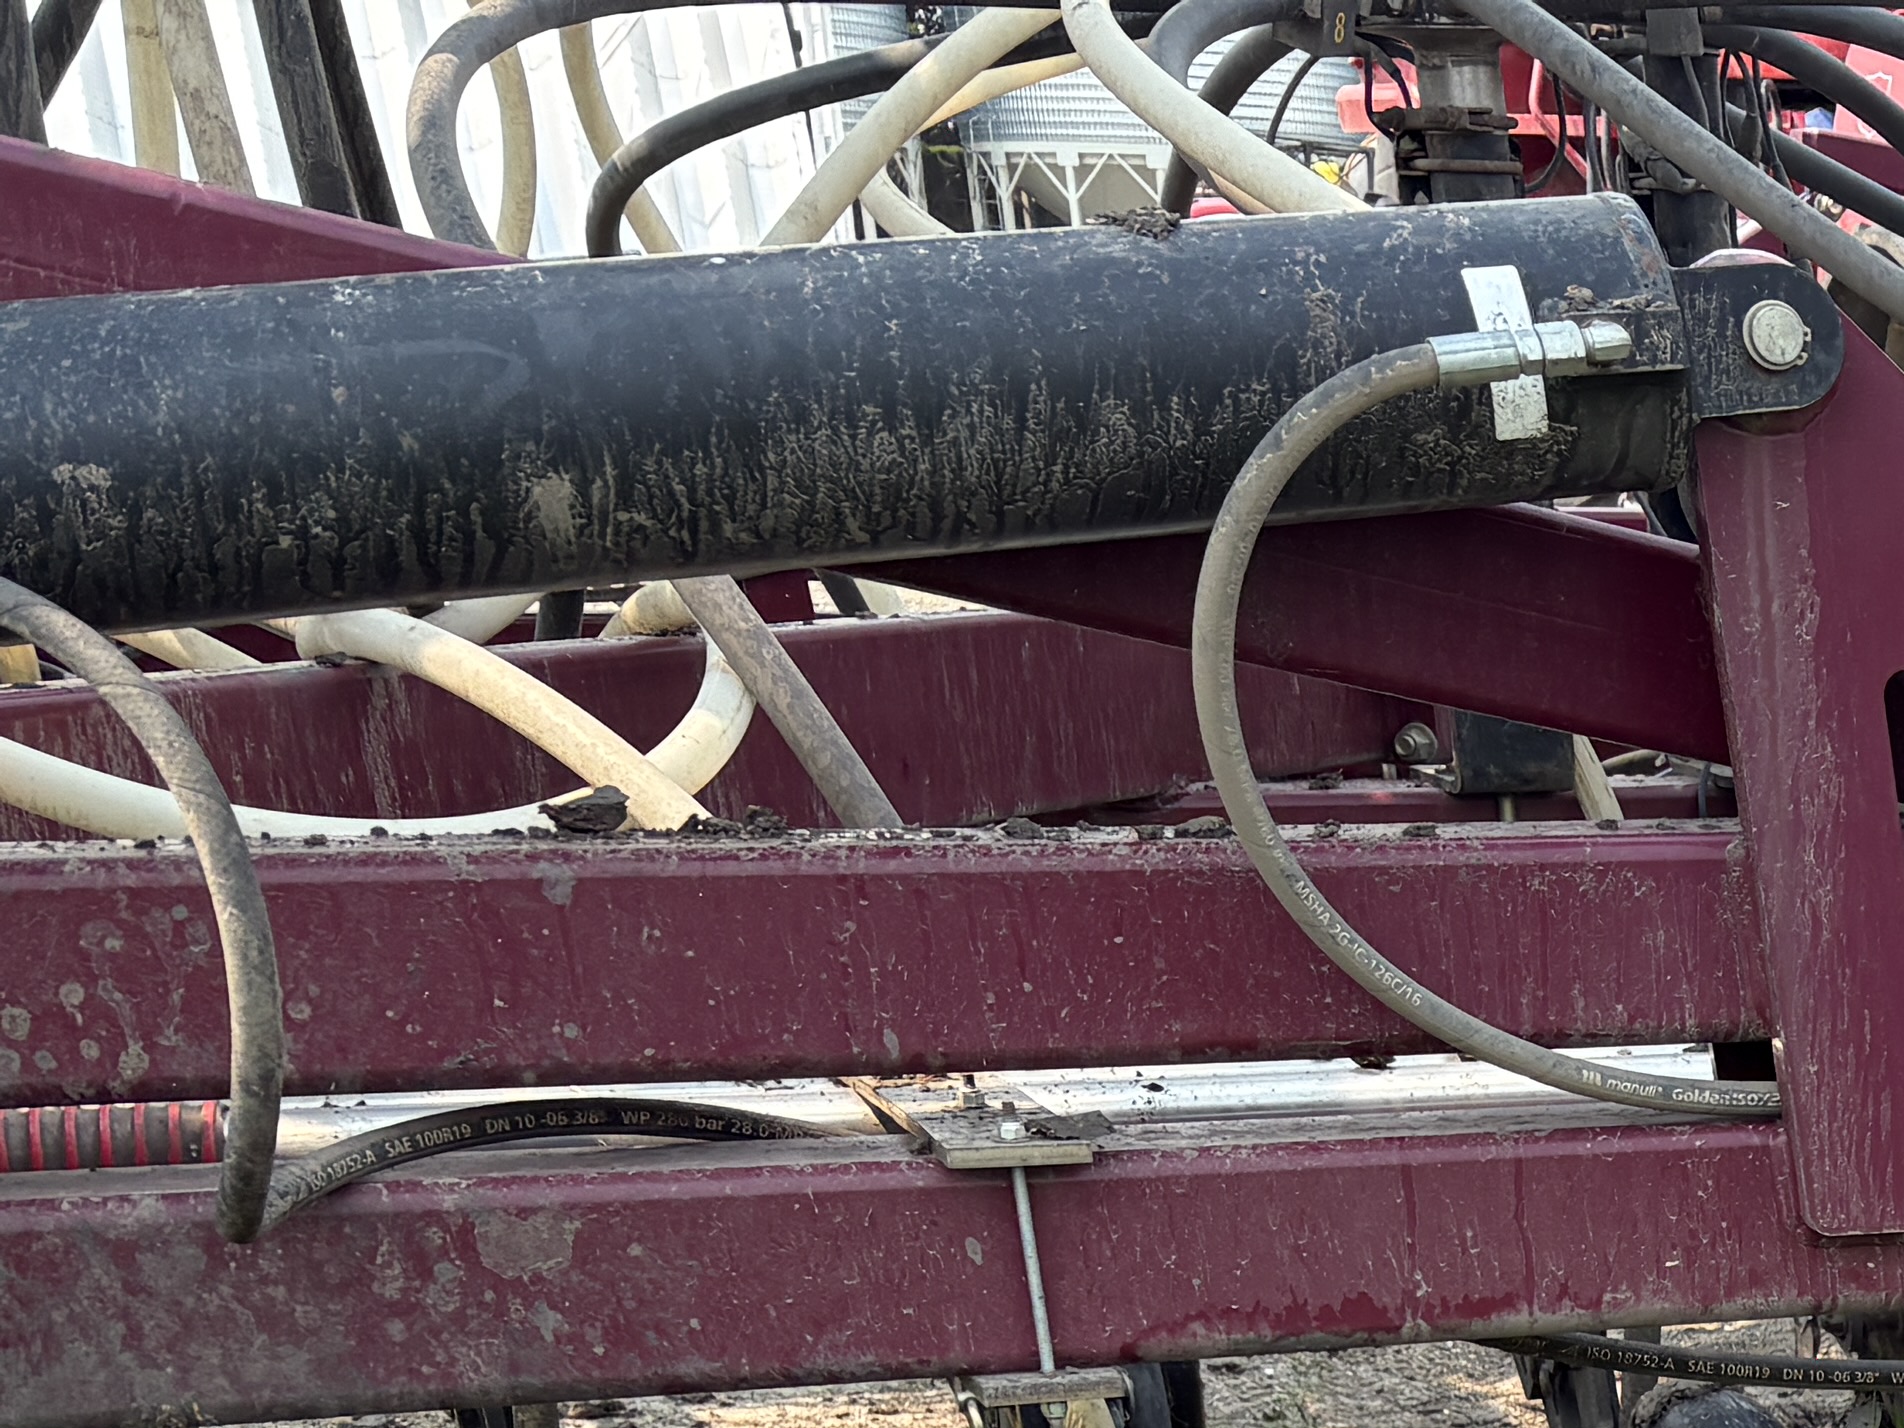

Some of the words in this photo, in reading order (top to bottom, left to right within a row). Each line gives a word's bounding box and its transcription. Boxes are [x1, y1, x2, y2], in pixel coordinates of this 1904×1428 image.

[1334, 12, 1346, 44] 8
[1295, 880, 1331, 926] MSHA
[384, 1137, 412, 1158] SAE
[416, 1123, 472, 1149] 100R19
[486, 1117, 511, 1134] DN
[518, 1113, 536, 1129] 10
[621, 1110, 651, 1125] WP
[695, 1114, 726, 1131] bar
[730, 1119, 769, 1138] 28.0
[1586, 1346, 1611, 1360] ISO
[1617, 1350, 1675, 1371] 18752-A
[1688, 1359, 1714, 1374] SAE
[1720, 1362, 1771, 1379] 100R19
[1783, 1367, 1804, 1381] DN
[1809, 1368, 1825, 1382] 10
